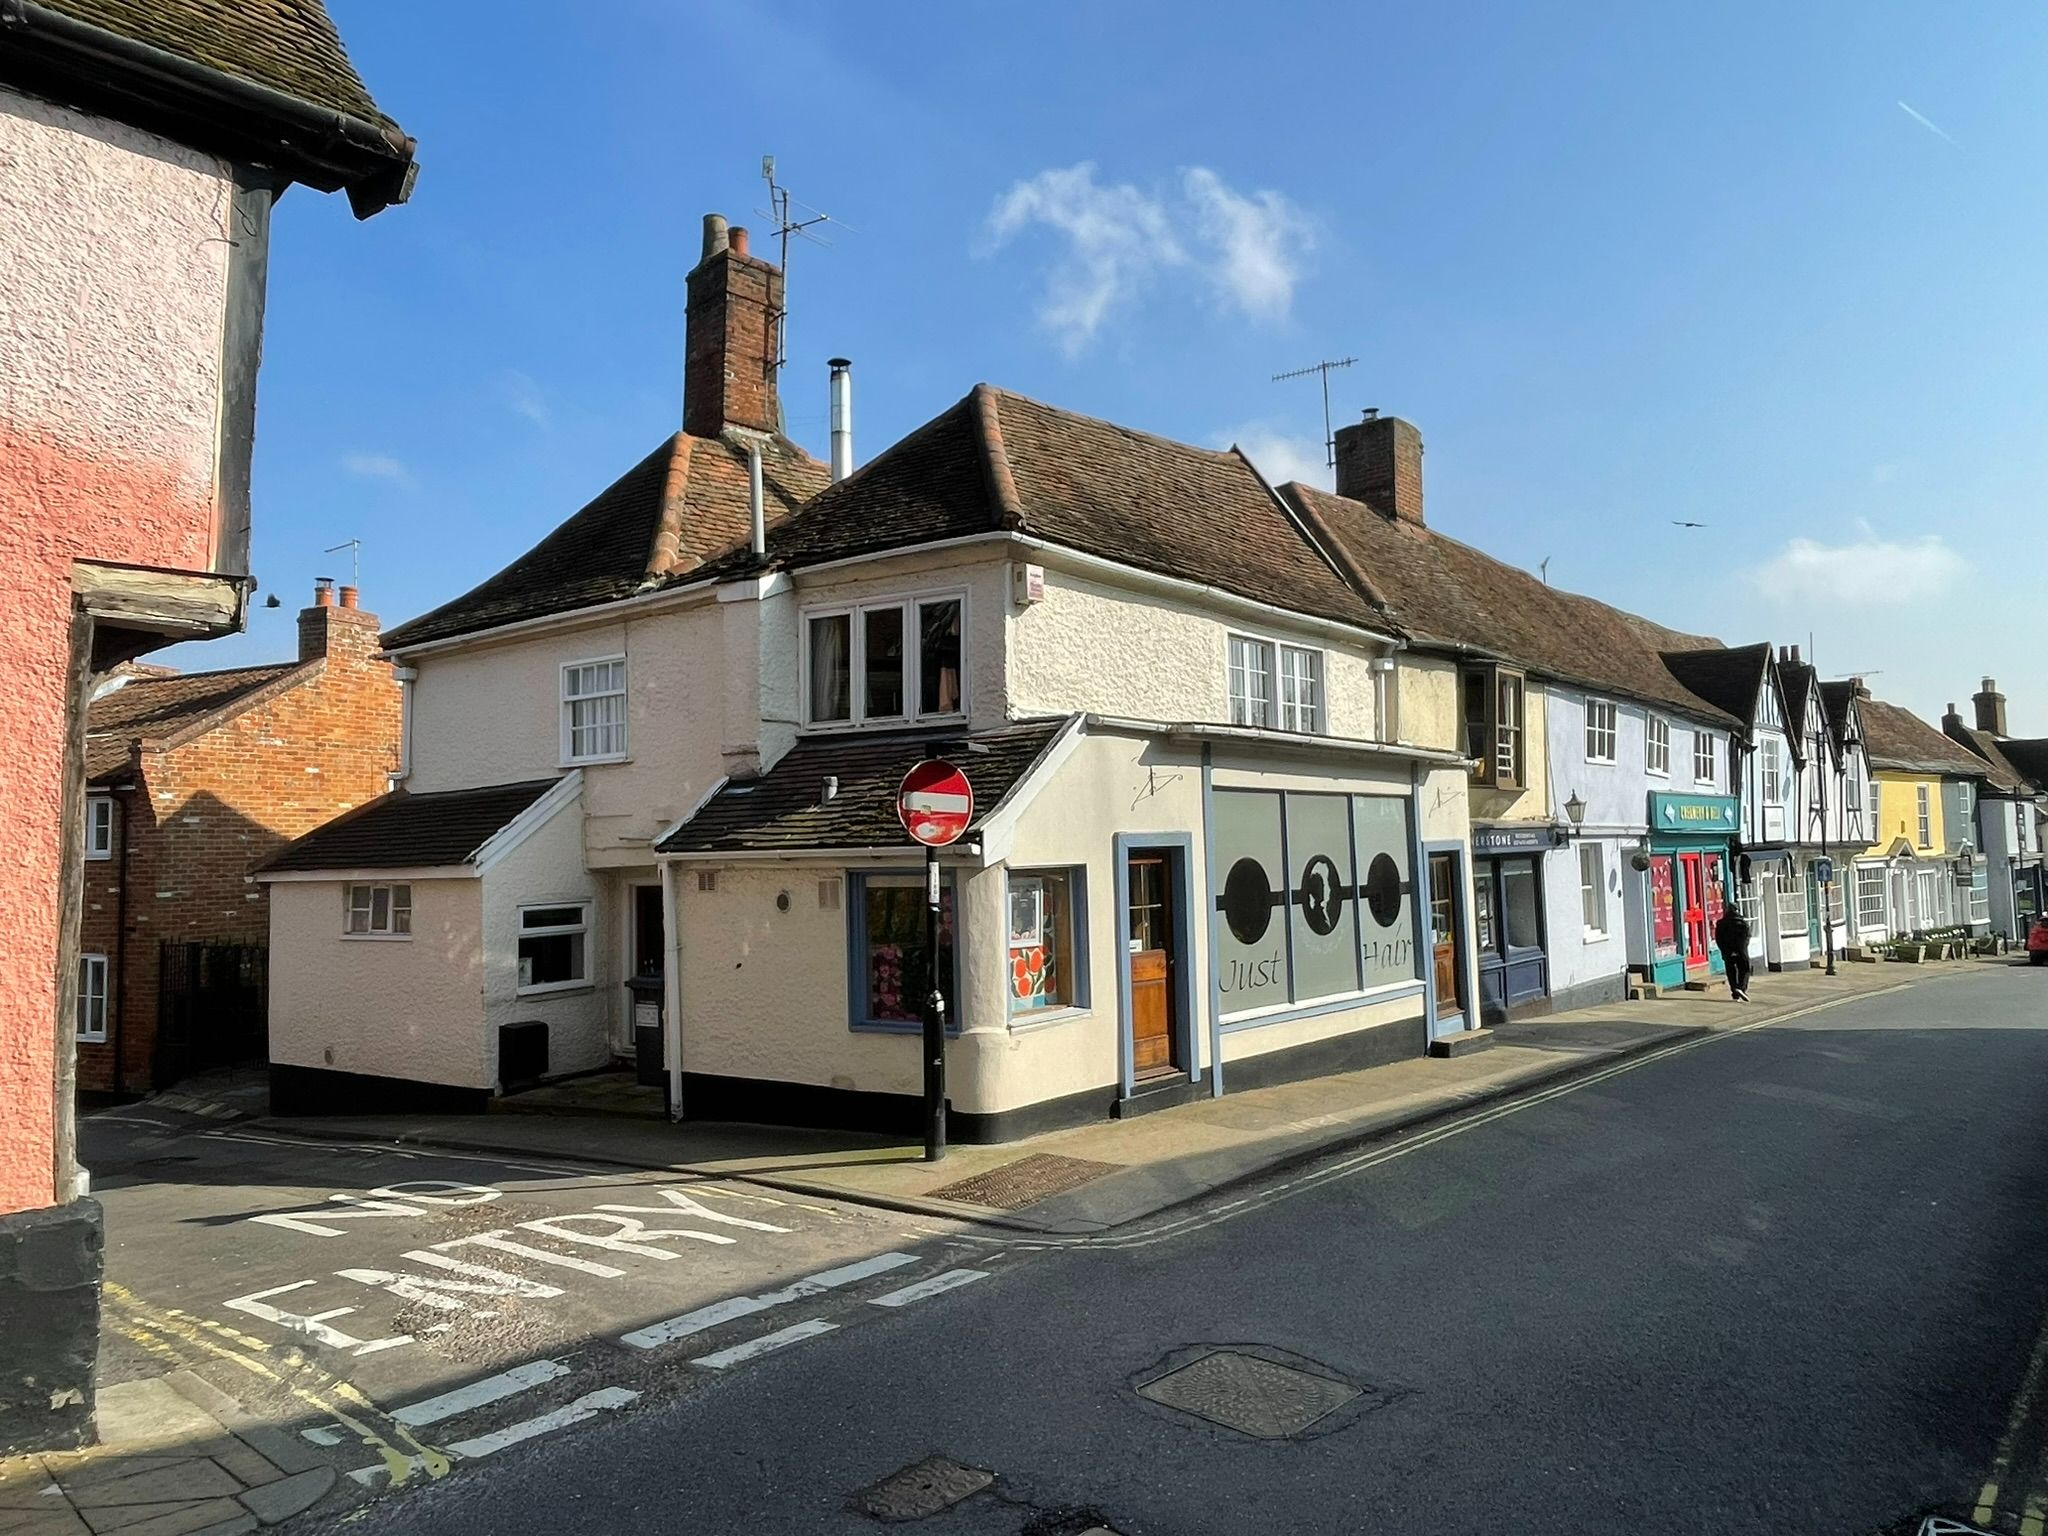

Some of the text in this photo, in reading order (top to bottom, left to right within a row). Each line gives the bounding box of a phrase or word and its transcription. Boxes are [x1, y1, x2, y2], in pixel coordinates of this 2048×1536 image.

[1218, 950, 1281, 993] Just
[1363, 923, 1414, 972] Hair
[248, 1181, 502, 1238] NO
[222, 1189, 793, 1356] ENTRY
